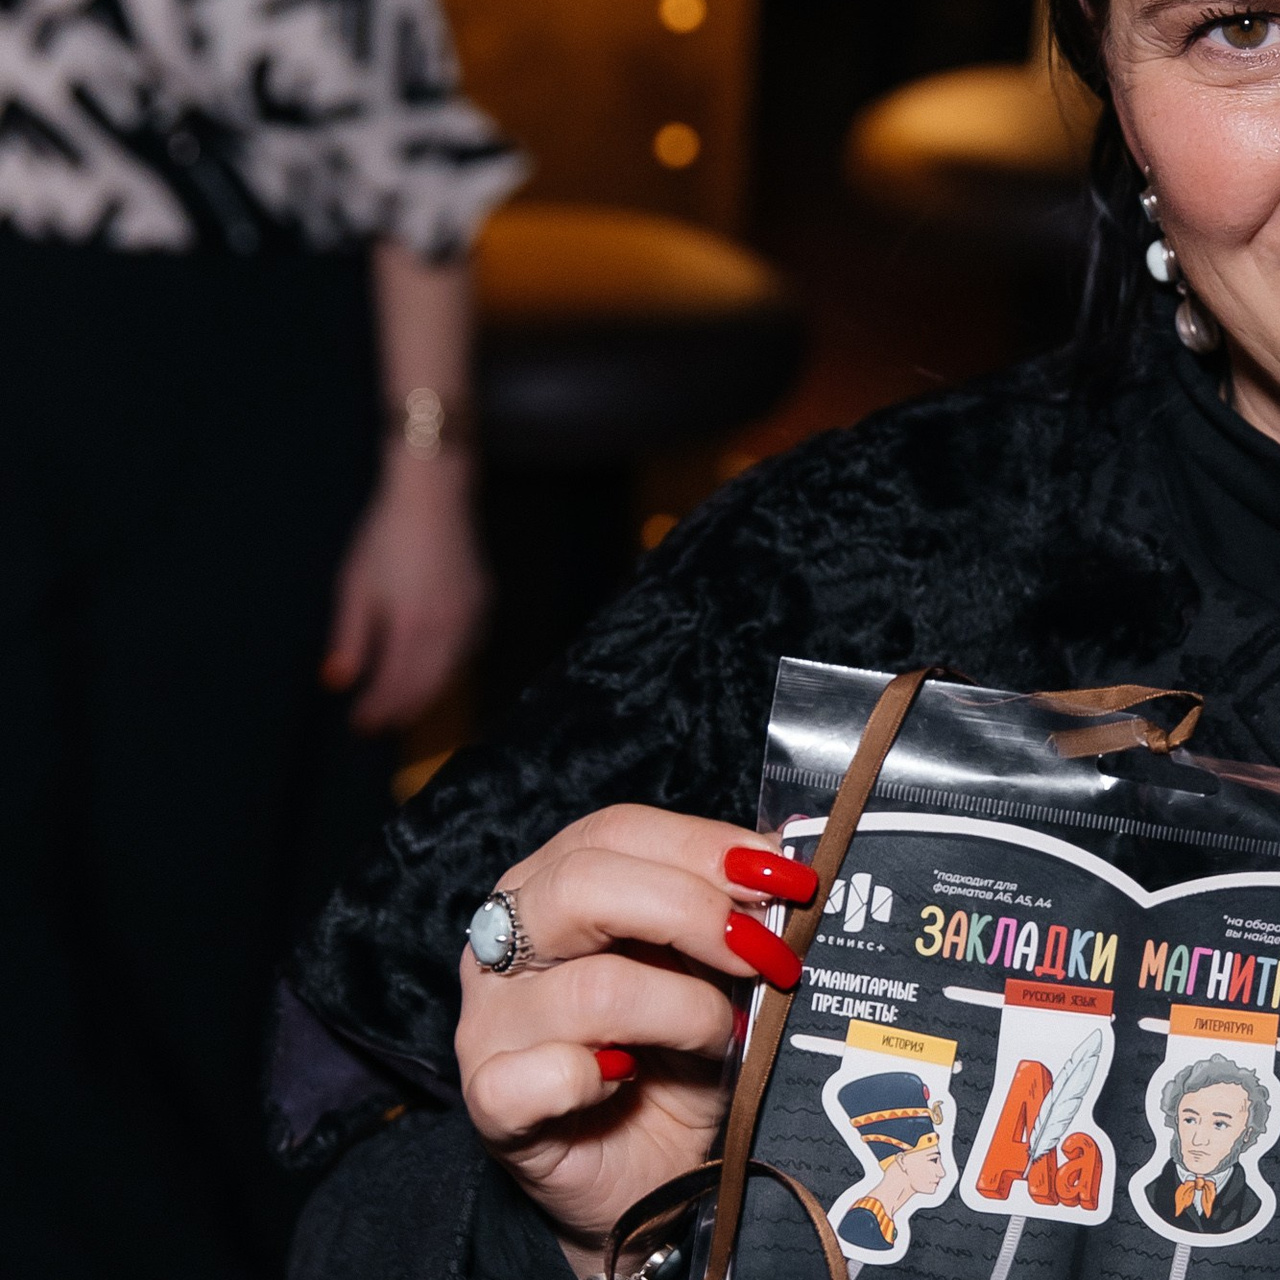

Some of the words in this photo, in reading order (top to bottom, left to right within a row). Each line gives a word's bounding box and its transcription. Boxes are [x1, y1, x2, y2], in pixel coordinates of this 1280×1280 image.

[933, 881, 994, 900] форматов
[993, 881, 1018, 891] для
[816, 933, 886, 953] ФЕНИКС+
[1225, 929, 1242, 938] вы
[915, 904, 1119, 984] ЗАКЛАДКИ
[811, 992, 899, 1023] ПРЕДМЕТЫ:
[1022, 989, 1065, 1006] РУССКИЙ
[1069, 994, 1099, 1008] ЯЗЫК
[1193, 1017, 1254, 1036] ЛИТЕРАТУРА
[882, 1034, 925, 1053] ИСТОРИЯ
